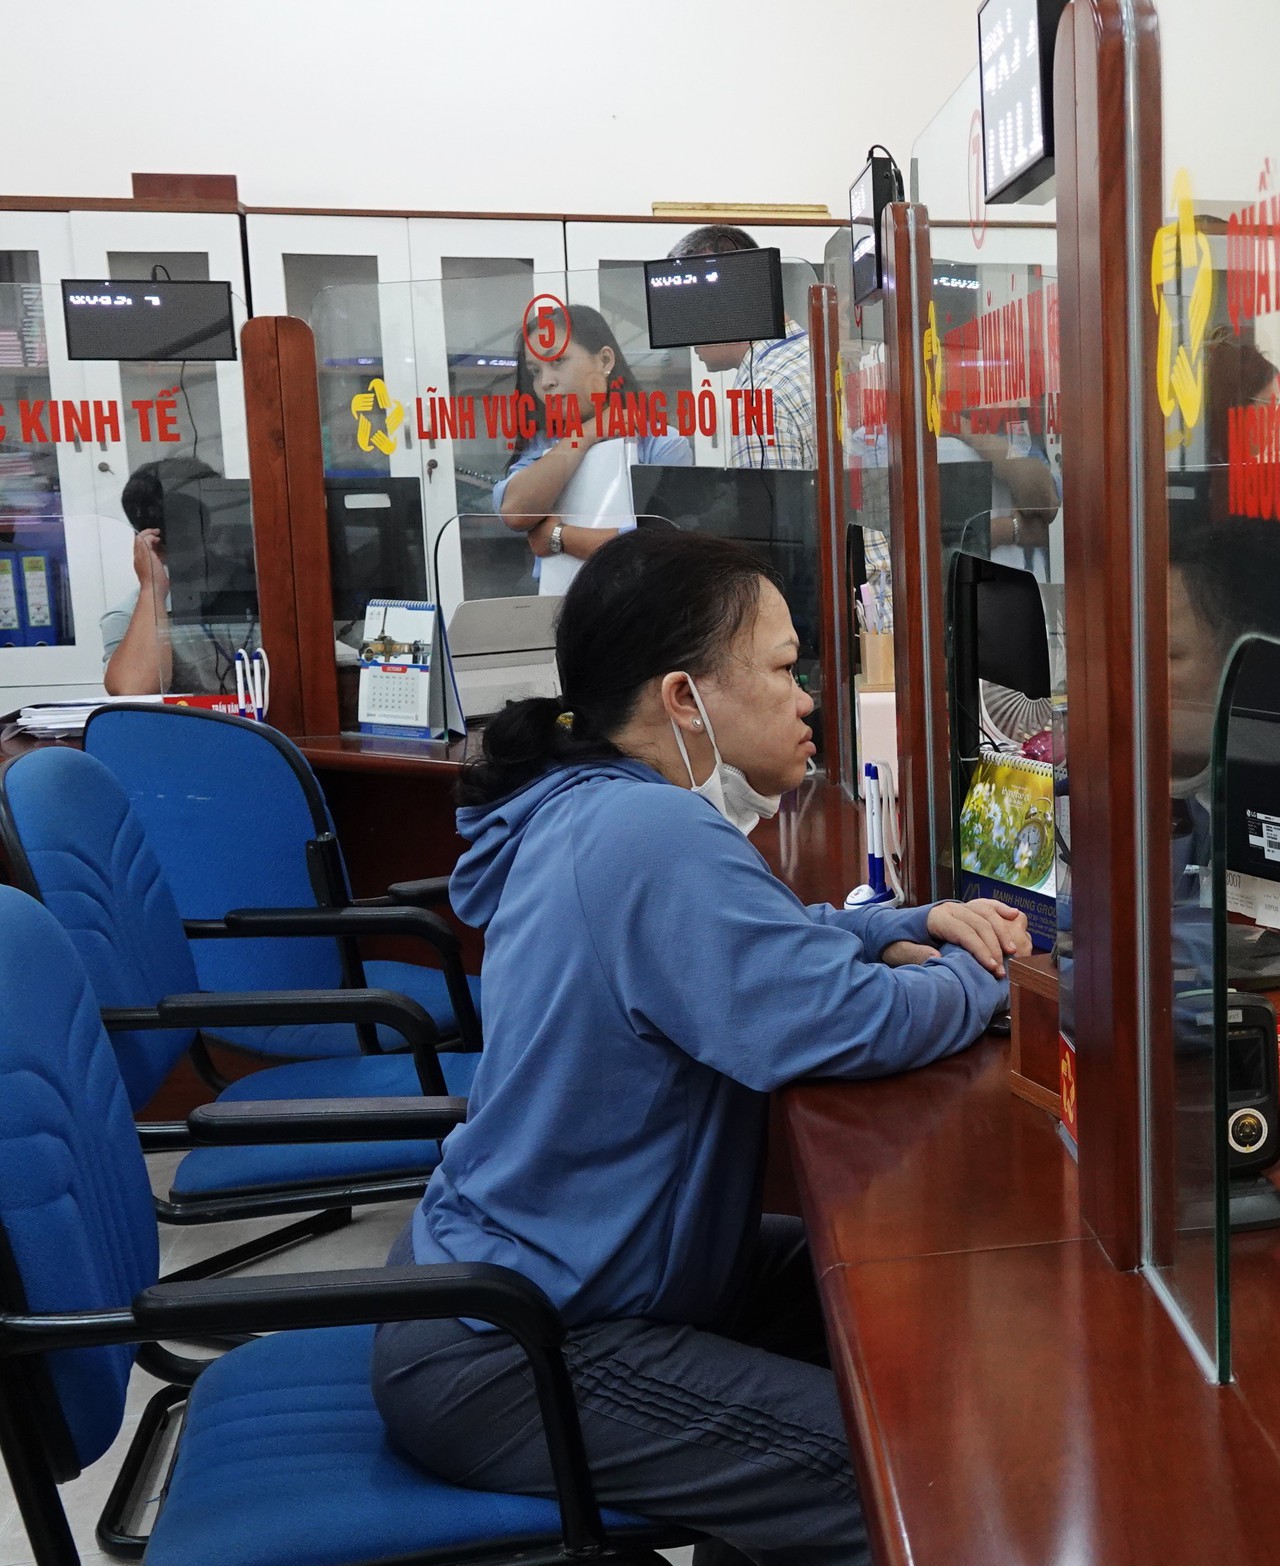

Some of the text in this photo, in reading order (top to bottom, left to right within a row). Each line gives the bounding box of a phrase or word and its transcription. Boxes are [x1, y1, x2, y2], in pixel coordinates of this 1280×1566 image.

[537, 306, 555, 349] 5
[18, 400, 121, 443] KINH
[131, 386, 181, 443] TẾ
[415, 386, 477, 440] LĨNH
[481, 389, 537, 450] VỰC
[544, 393, 585, 449] HẠ
[590, 376, 669, 440] TẦNG
[676, 378, 718, 437] ĐÔ
[725, 388, 776, 447] THỊ
[1037, 903, 1057, 918] GROU
